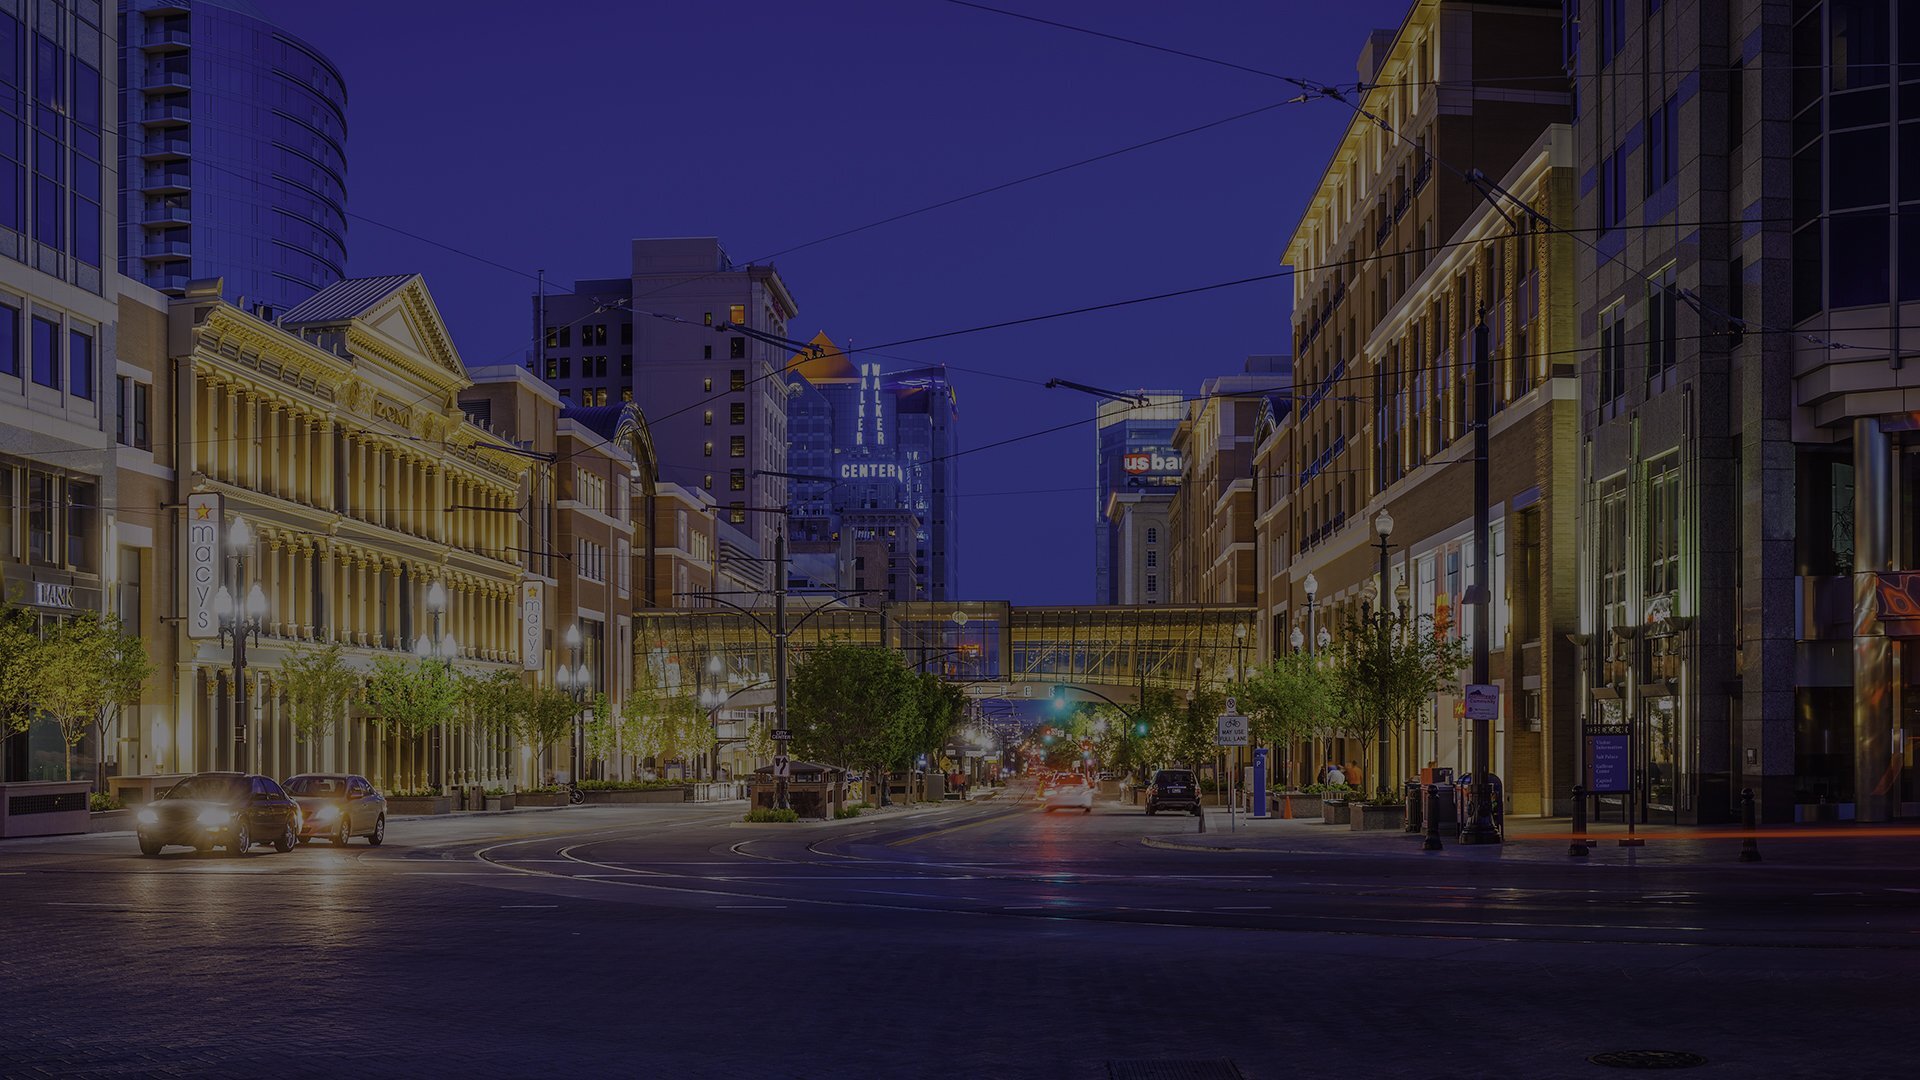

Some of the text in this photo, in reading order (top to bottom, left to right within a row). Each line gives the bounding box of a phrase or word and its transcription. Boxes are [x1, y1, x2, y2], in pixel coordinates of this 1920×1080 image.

[856, 363, 869, 445] WALKER
[872, 363, 885, 445] WALKER
[841, 464, 896, 479] CENTER
[36, 582, 74, 608] BANK
[192, 525, 214, 628] macys
[525, 601, 540, 665] macys
